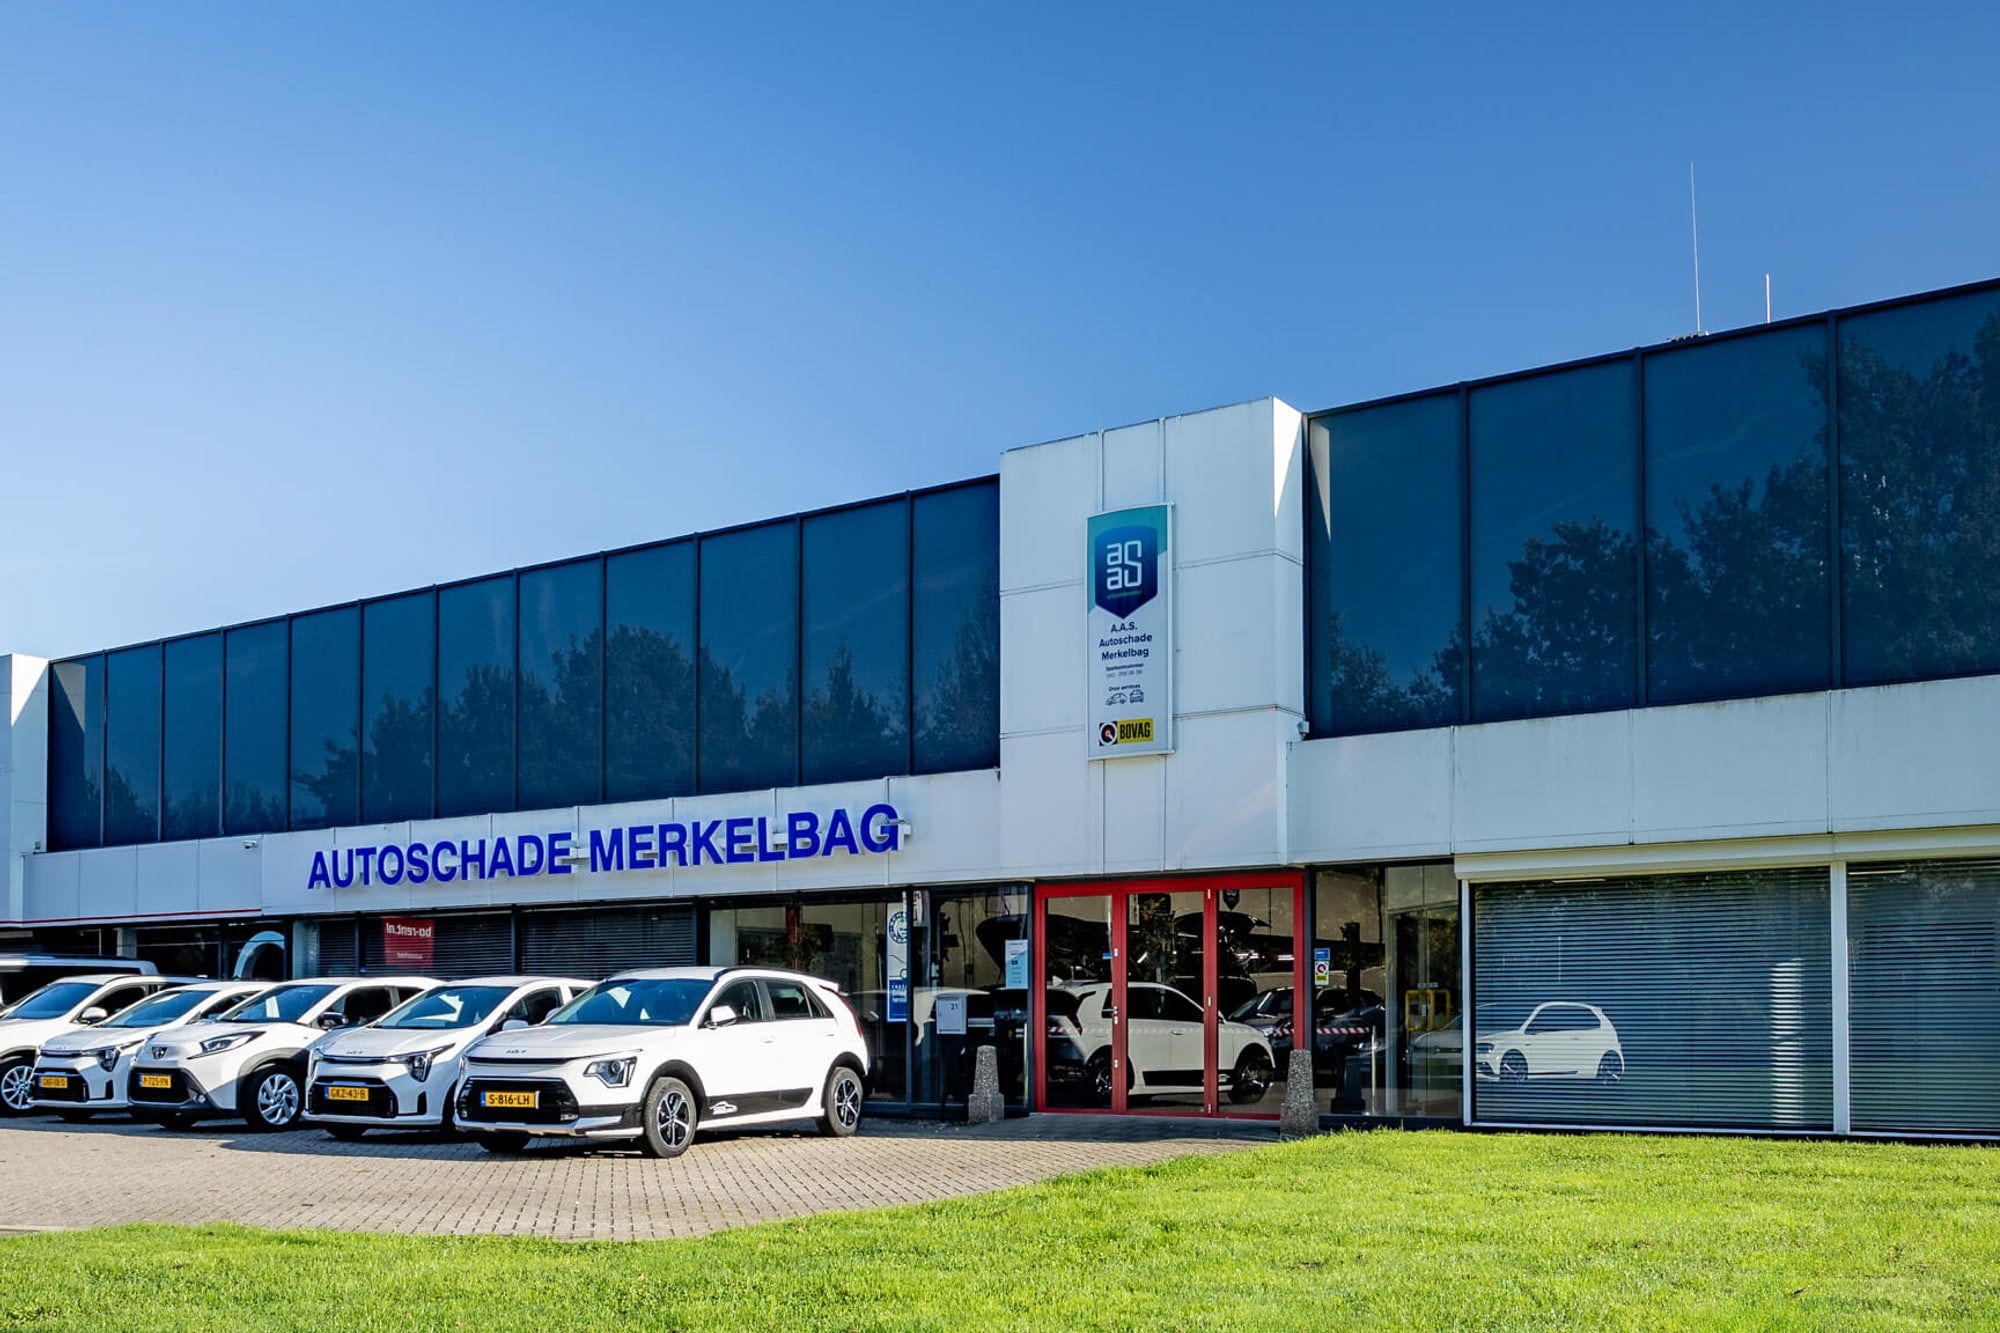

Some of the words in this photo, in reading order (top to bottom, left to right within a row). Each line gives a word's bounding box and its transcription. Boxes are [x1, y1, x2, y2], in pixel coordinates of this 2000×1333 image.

[1110, 621, 1138, 633] A.A.S.
[1099, 633, 1153, 648] Autoschade
[1101, 648, 1149, 661] Merkelbag
[1120, 722, 1151, 740] BOVAG
[308, 831, 573, 890] AUTOSCHADE
[589, 803, 901, 874] MERKELBAG
[488, 1094, 531, 1106] S-816-LH
